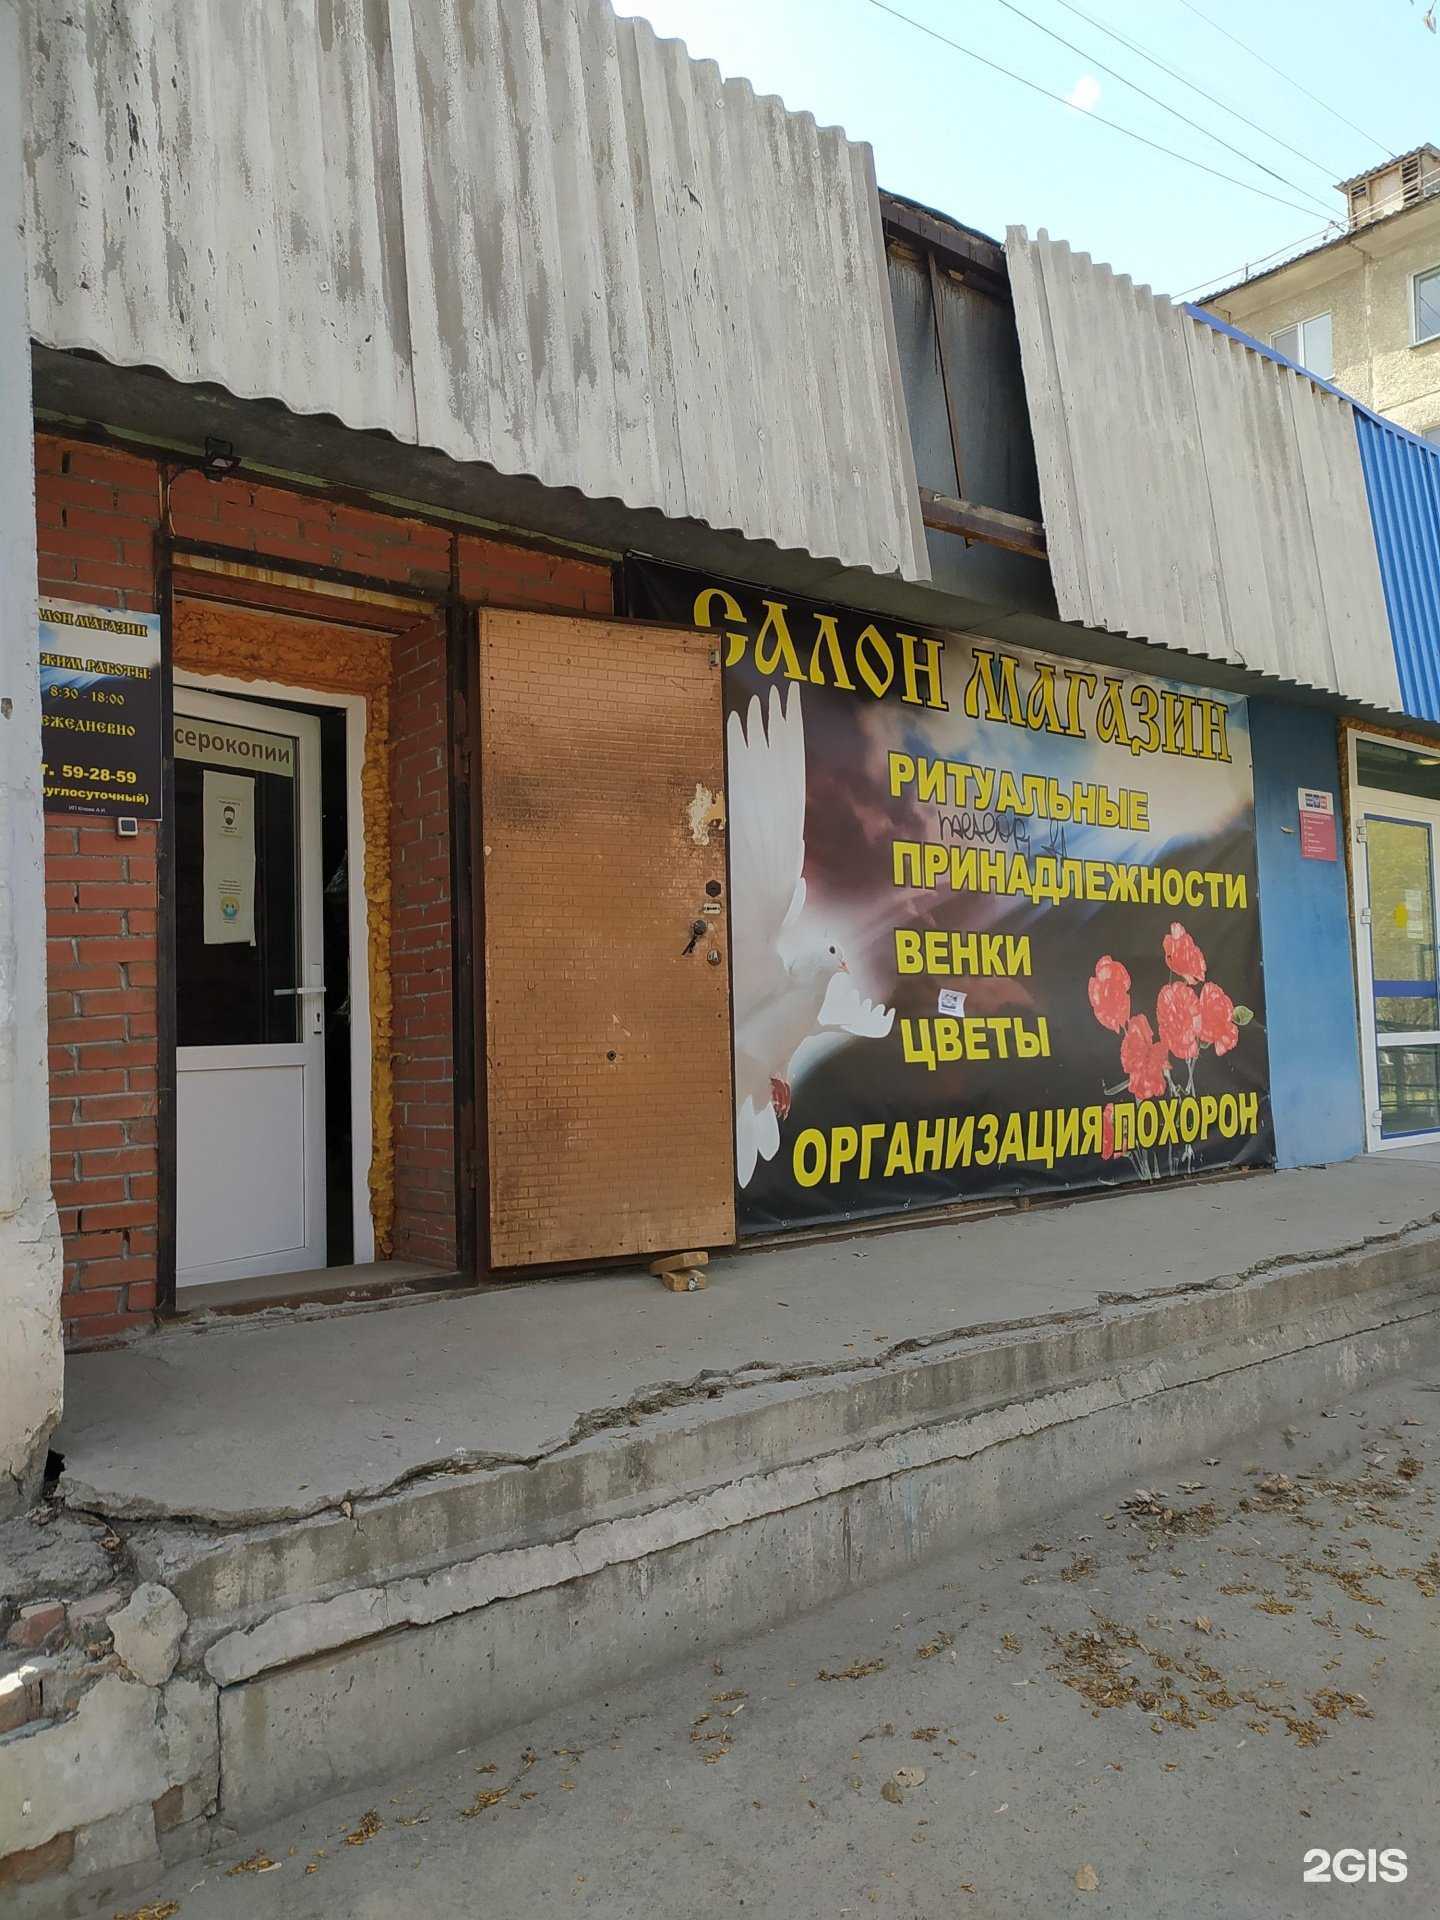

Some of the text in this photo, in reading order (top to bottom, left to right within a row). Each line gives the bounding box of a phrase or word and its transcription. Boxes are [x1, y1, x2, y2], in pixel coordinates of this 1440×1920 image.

[76, 615, 148, 637] МАГАЗИН
[85, 658, 152, 680] РАБОТЫ:
[693, 588, 1232, 763] САЛОН МАГАЗИН
[50, 685, 79, 699] 8:30
[91, 691, 125, 705] 18:00
[41, 715, 136, 736] ЕЖЕДНЕВНО
[174, 728, 290, 763] серокопии
[62, 764, 137, 783] 59-28-59
[888, 751, 1150, 832] РИТУАЛЬНЫЕ
[892, 840, 1248, 909] ПРИНАДЛЕЖНОСТИ
[894, 927, 1033, 977] ВЕНКИ
[900, 1016, 1052, 1071] ЦВЕТЫ
[792, 1092, 1258, 1188] ОРГАНИЗАЦИЯ ПОХОРОН
